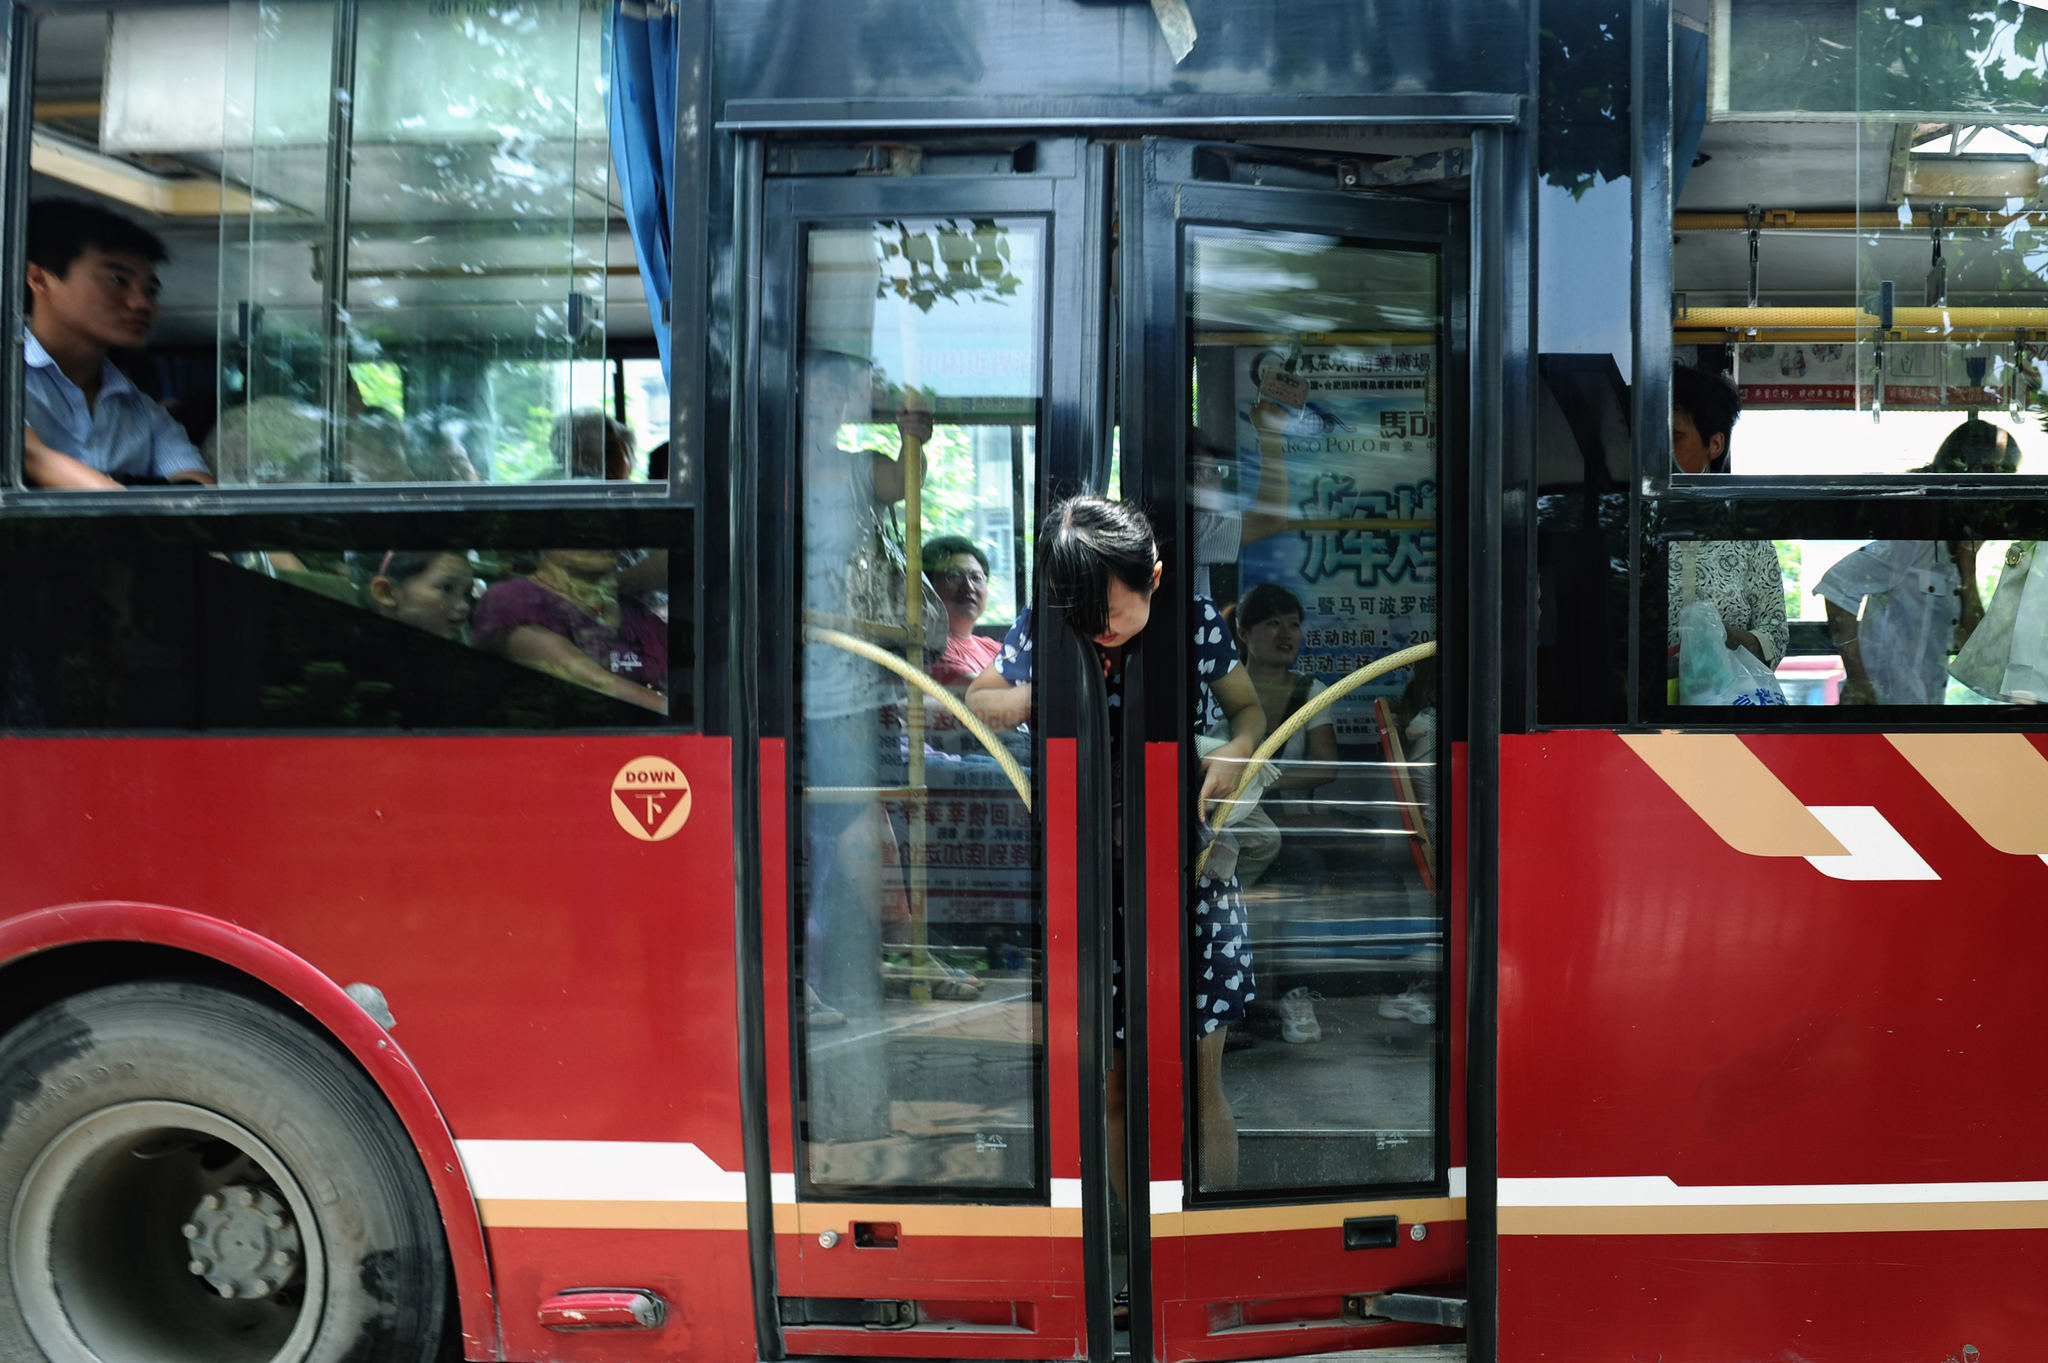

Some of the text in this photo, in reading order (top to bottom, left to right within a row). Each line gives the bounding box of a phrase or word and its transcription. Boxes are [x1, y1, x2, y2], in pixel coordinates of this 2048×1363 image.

[1326, 436, 1375, 453] POLO
[626, 771, 675, 783] DOWN
[635, 791, 666, 824] 下
